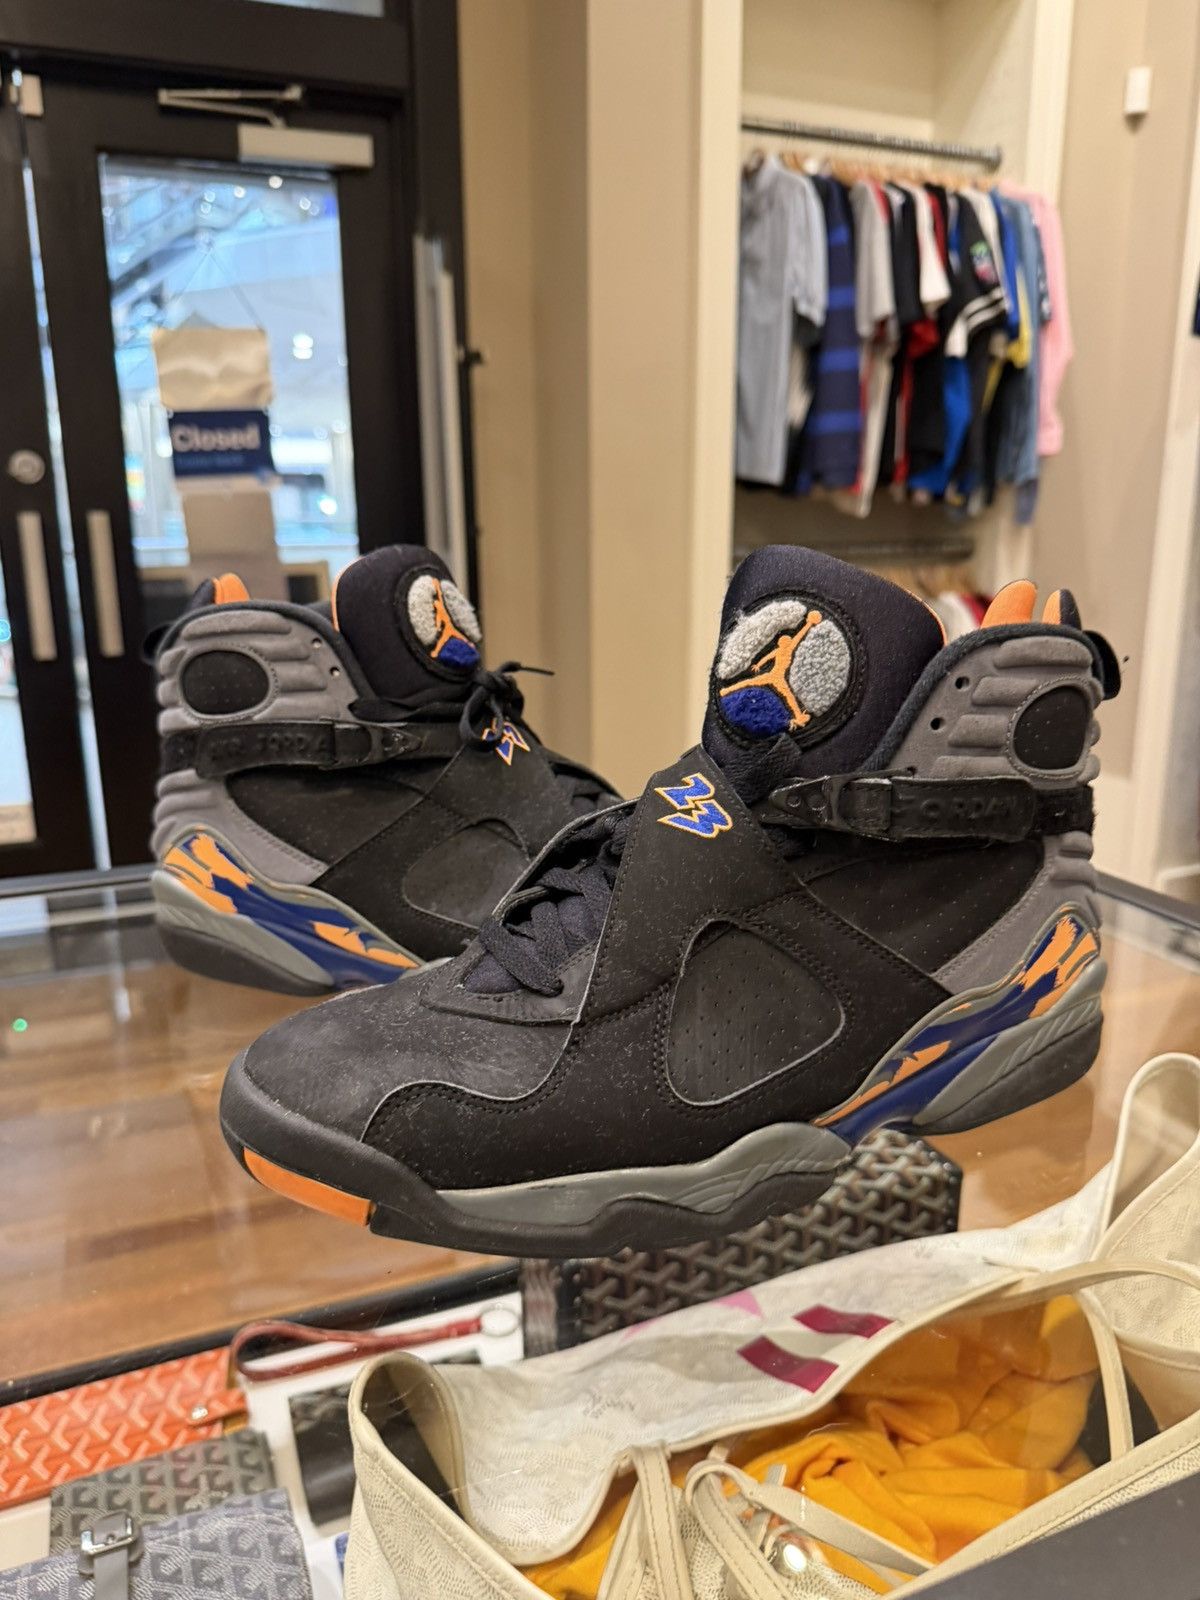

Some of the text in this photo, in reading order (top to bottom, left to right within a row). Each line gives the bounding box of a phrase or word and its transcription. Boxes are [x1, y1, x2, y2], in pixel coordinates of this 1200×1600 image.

[171, 423, 259, 452] Closed
[255, 731, 331, 753] JORDA
[654, 772, 733, 838] 23
